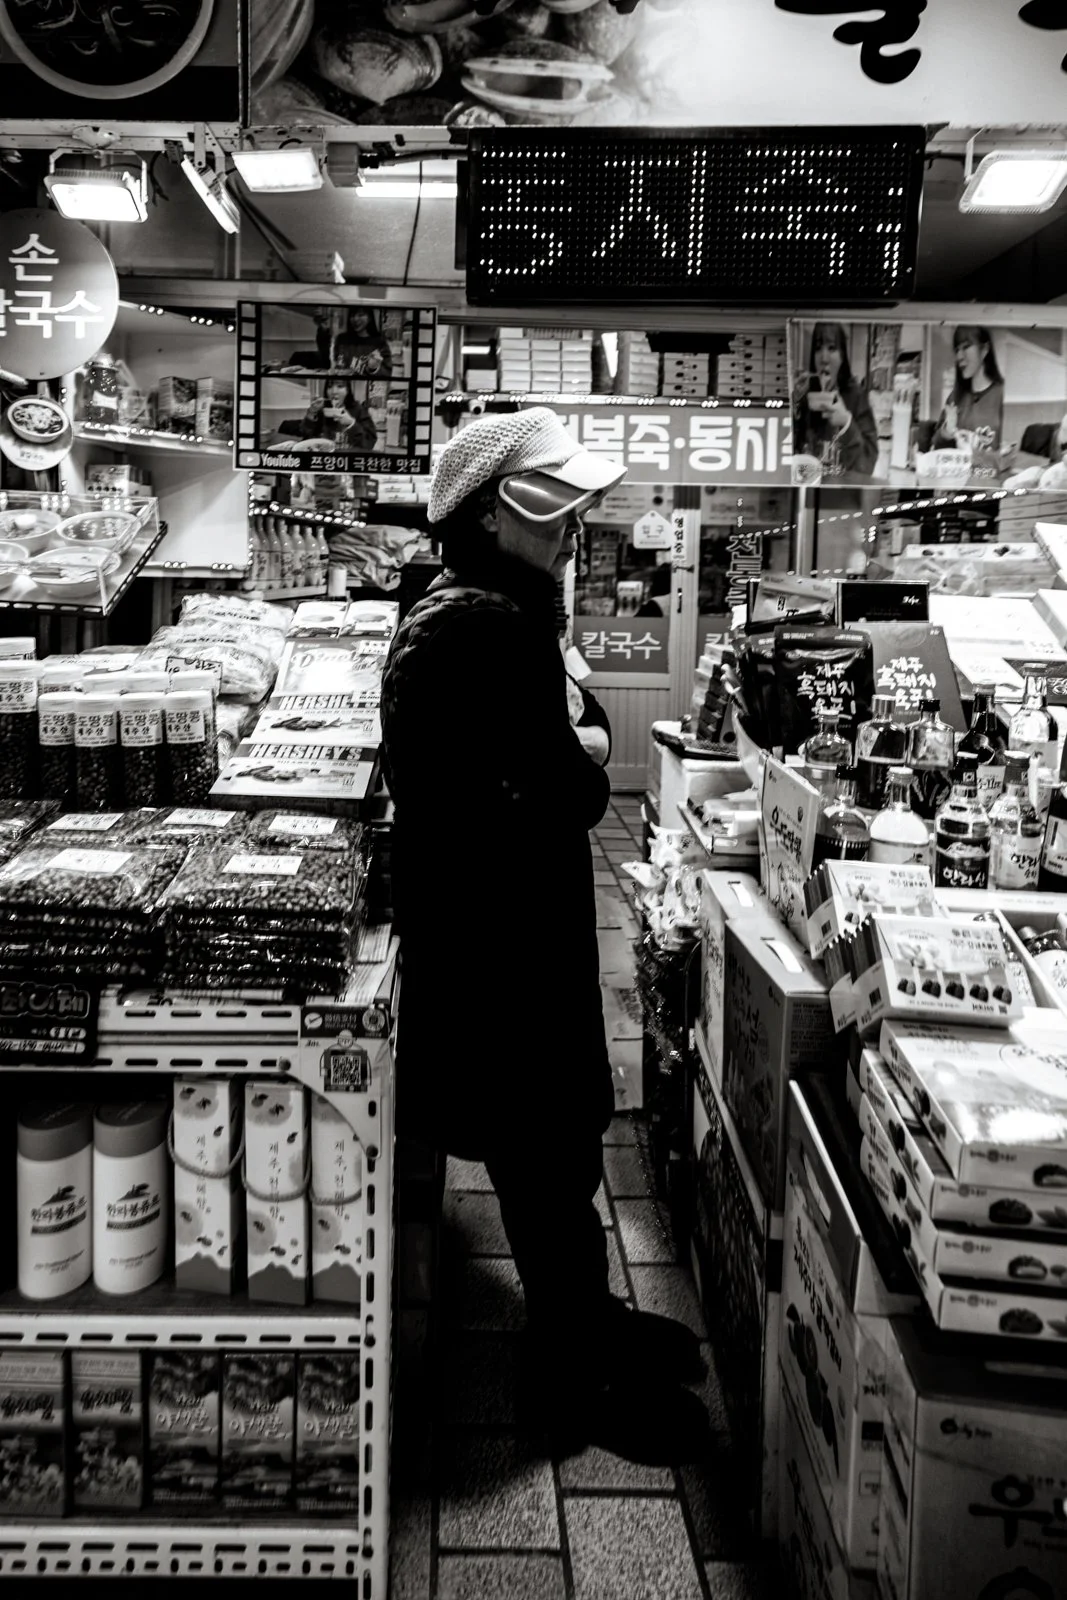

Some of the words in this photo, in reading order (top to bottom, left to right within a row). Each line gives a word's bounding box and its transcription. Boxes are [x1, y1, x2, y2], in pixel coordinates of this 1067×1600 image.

[9, 233, 60, 282] 손
[565, 413, 792, 473] 복죽·동지
[260, 453, 301, 468] YouTube
[581, 631, 662, 660] 칼국수
[815, 663, 845, 679] 제주
[889, 656, 924, 673] 제주
[797, 671, 855, 700] 흑돼지
[876, 664, 937, 690] 흑돼지
[279, 695, 379, 710] HERSHE
[249, 744, 363, 761] HERSHEY'S
[943, 865, 986, 887] 한라산
